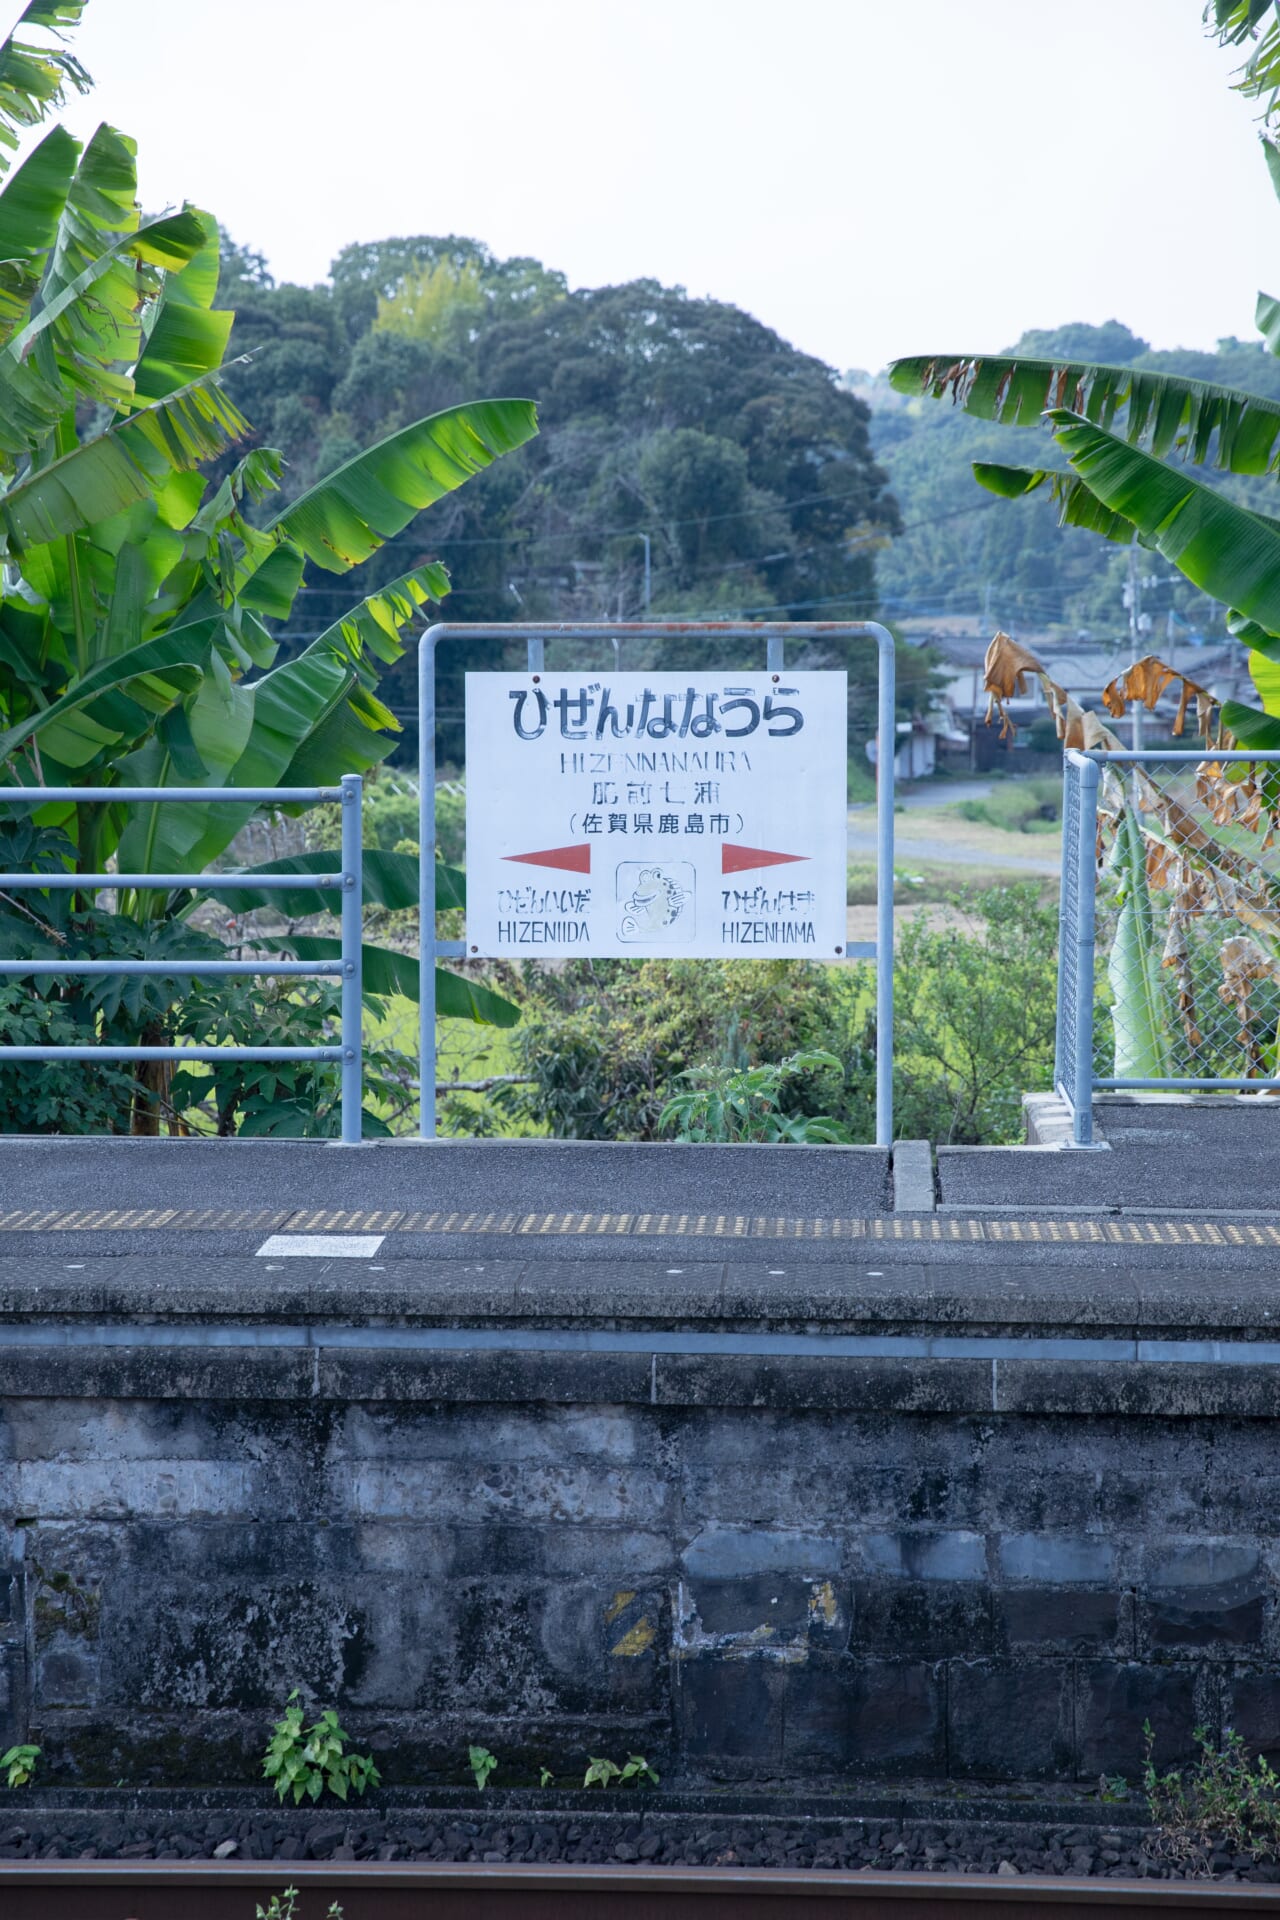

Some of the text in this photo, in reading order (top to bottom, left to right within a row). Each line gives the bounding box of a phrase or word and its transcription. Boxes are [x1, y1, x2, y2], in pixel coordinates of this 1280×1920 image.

[508, 682, 805, 740] ひぜんななうら
[721, 886, 816, 915] ひぜんはま
[498, 921, 590, 943] HIZENIIDA
[722, 921, 816, 944] HIZENHAMA
